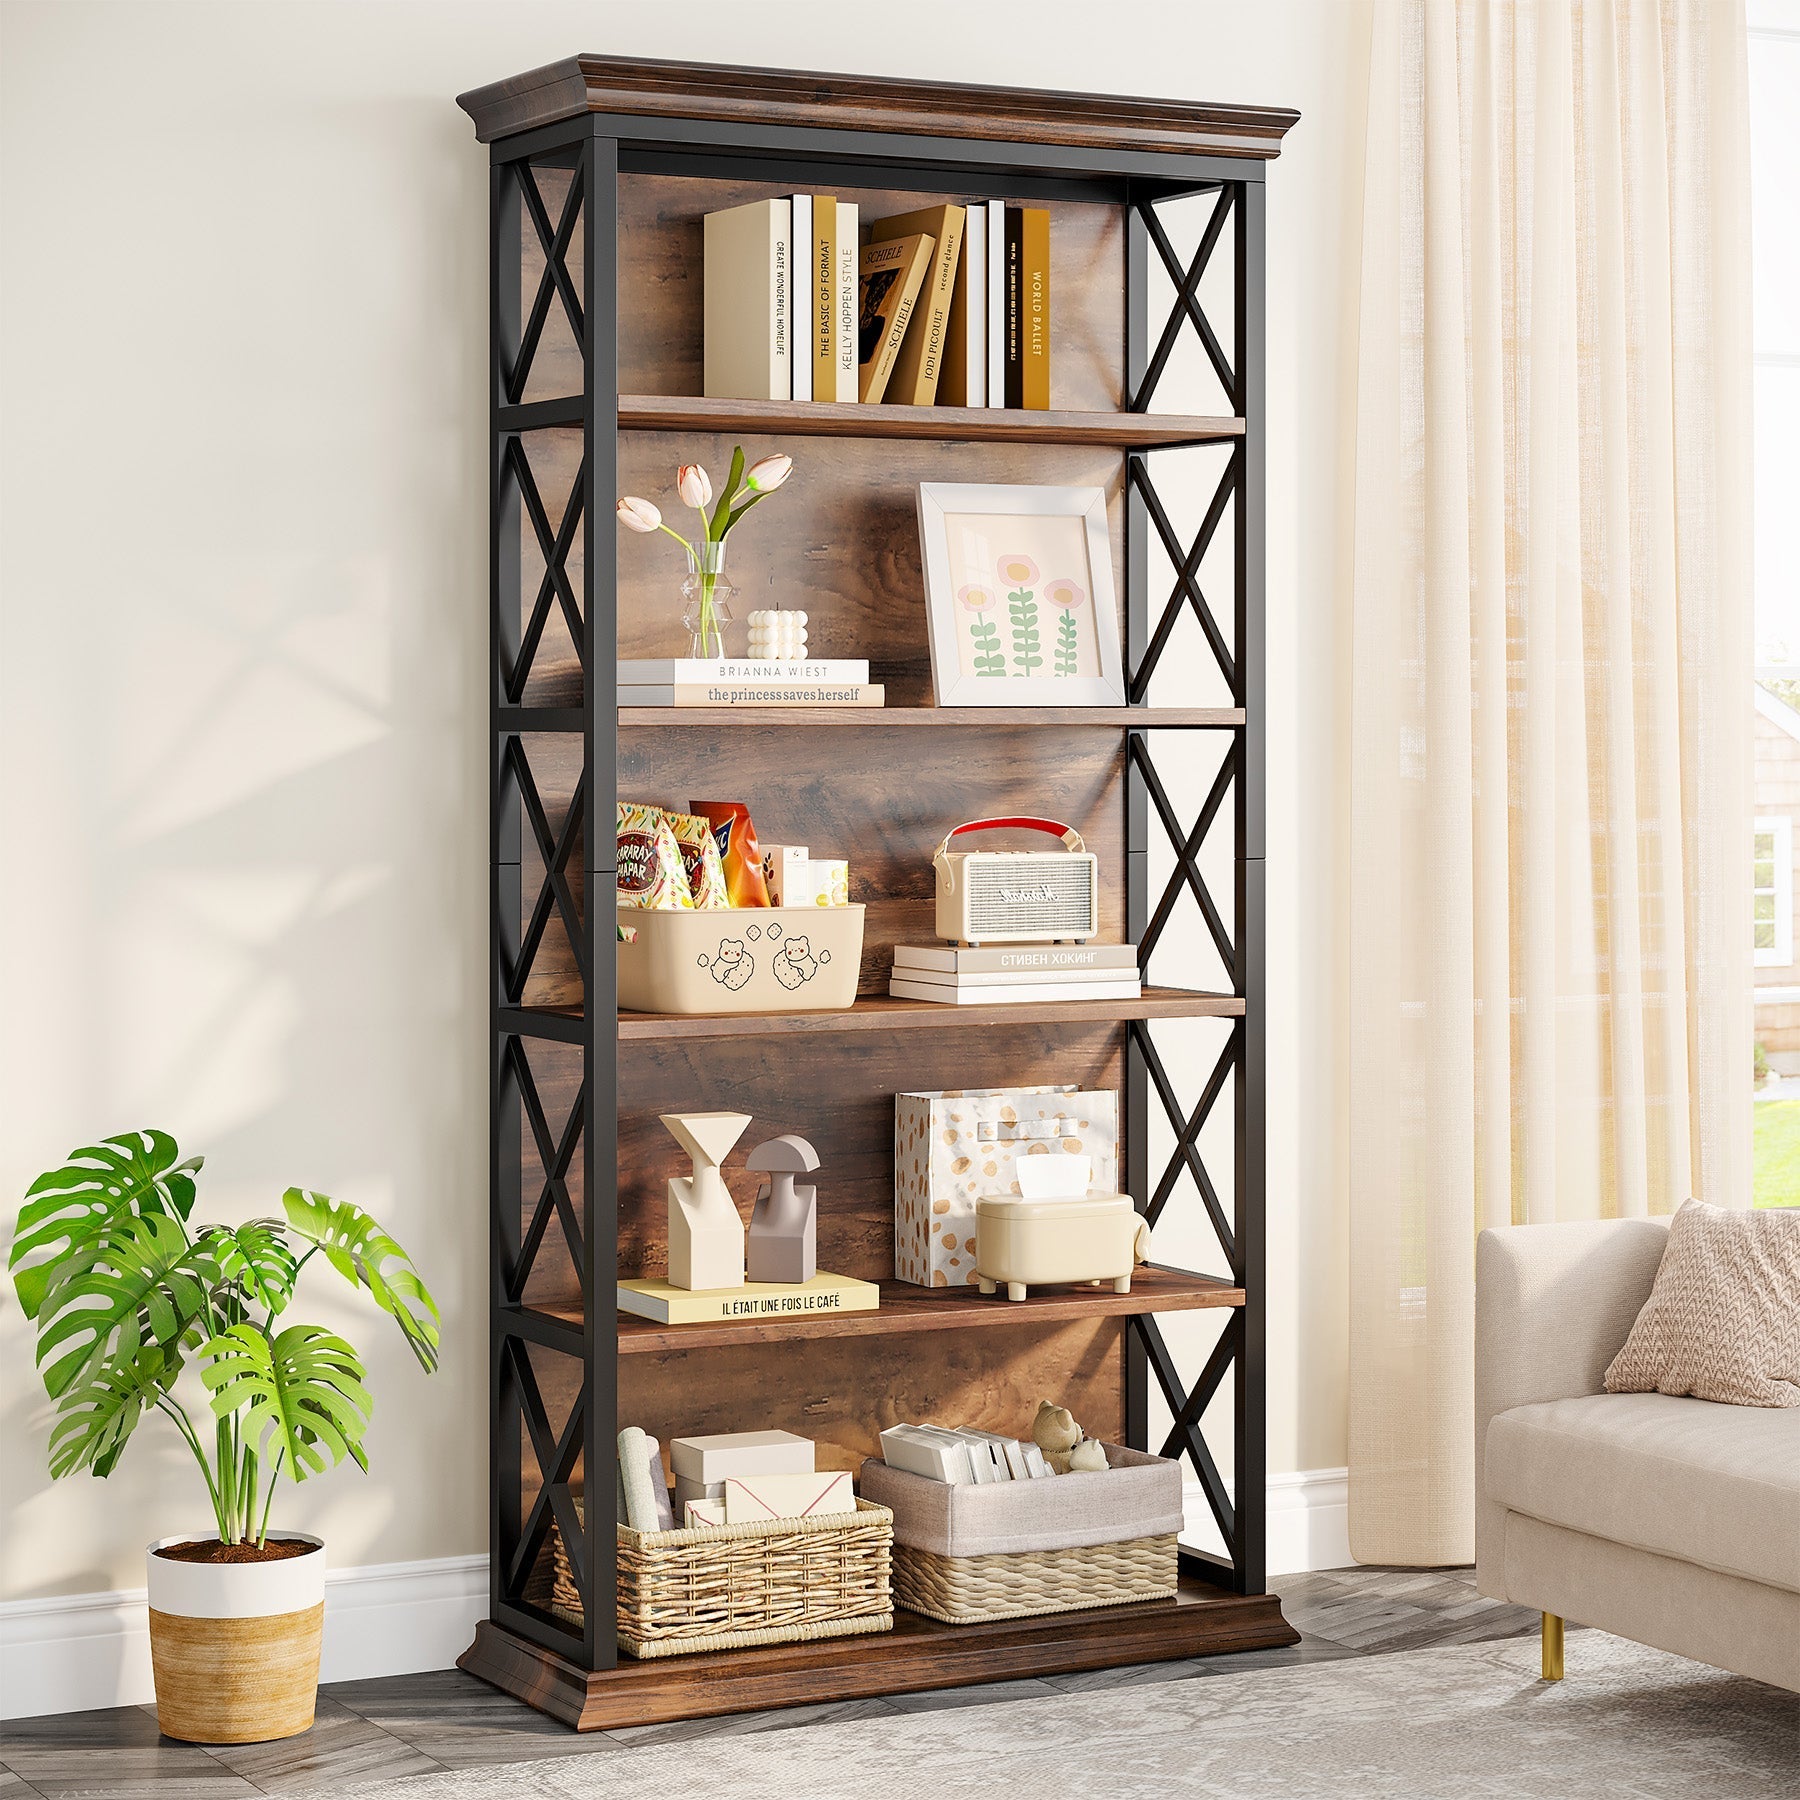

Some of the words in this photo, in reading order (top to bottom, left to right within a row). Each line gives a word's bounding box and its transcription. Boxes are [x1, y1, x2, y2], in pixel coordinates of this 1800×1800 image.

[776, 241, 785, 269] CREATE
[821, 239, 829, 283] FORMAT
[843, 249, 852, 283] STYLE
[865, 245, 904, 265] SCHIELE
[940, 263, 949, 291] second
[945, 234, 954, 261] glance
[776, 271, 785, 317] WONDERFUL
[821, 286, 829, 301] OF
[1032, 271, 1042, 312] WORLD
[821, 304, 829, 334] BASIC
[843, 286, 852, 333] HOPPEN
[889, 297, 913, 349] SCHIELE
[776, 319, 785, 356] HOMELIFE
[821, 337, 829, 357] THE
[929, 308, 944, 354] PICOULT
[1032, 317, 1042, 356] BALLET
[843, 335, 852, 370] KELLY
[924, 354, 935, 381] JODI
[719, 666, 782, 677] BRIANNA
[788, 666, 828, 677] WIEST
[708, 688, 729, 701] the
[730, 688, 782, 704] princess
[783, 691, 816, 701] saves
[817, 688, 860, 701] herself
[1001, 953, 1048, 967] СТИВЕН
[1051, 952, 1098, 965] ХОКИНГ
[722, 1303, 731, 1315] IL
[733, 1300, 758, 1314] ÉTAIT
[761, 1299, 779, 1312] UNE
[782, 1298, 802, 1311] FOIS
[804, 1297, 815, 1309] LE
[817, 1292, 840, 1308] CAFÉ
